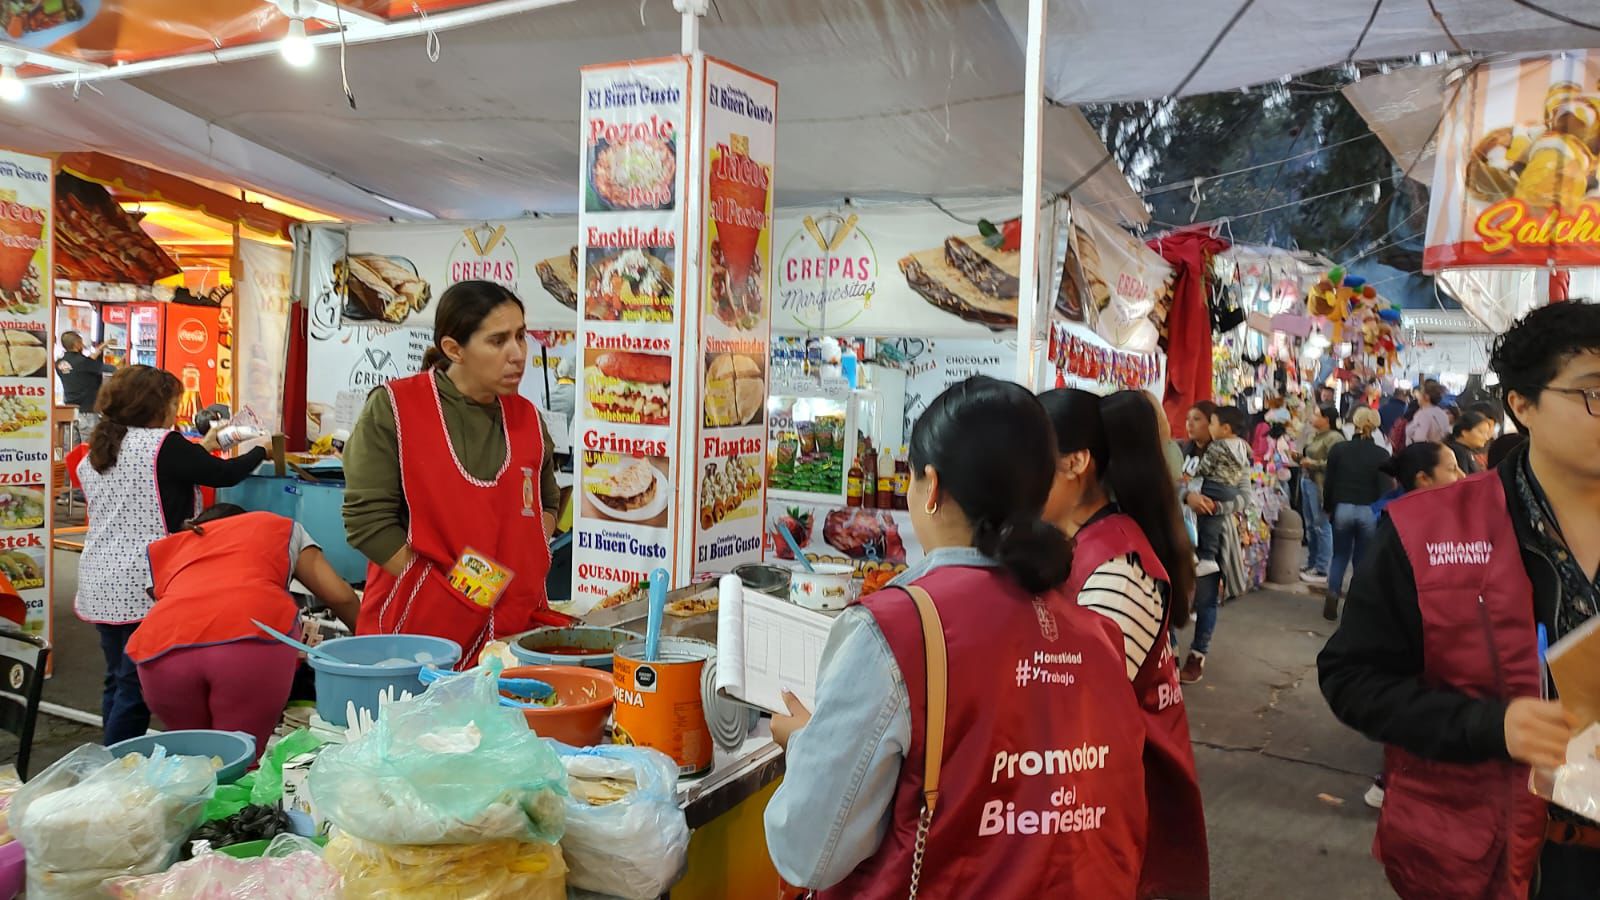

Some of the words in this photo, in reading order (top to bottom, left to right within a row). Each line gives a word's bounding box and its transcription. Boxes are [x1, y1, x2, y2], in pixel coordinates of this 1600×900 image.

[587, 89, 601, 109] El
[604, 87, 637, 108] Buen
[639, 86, 680, 105] Gusto
[709, 83, 719, 107] El
[720, 86, 745, 116] Buen
[746, 97, 773, 124] Gusto
[589, 114, 674, 146] Pozole
[717, 143, 769, 190] Tacos
[628, 181, 672, 209] Rojo
[587, 226, 675, 249] Enchiladas
[452, 261, 514, 283] CREPAS
[786, 256, 870, 283] CREPAS
[585, 332, 671, 350] Pambazos
[946, 355, 1000, 365] CHOCOLATE
[16, 450, 48, 462] Gusto
[584, 429, 667, 459] Gringas
[703, 436, 761, 459] Flautas
[578, 531, 592, 548] El
[595, 533, 626, 553] Buen
[629, 538, 667, 559] Gusto
[698, 544, 708, 563] El
[709, 543, 734, 560] Buen
[735, 536, 760, 553] Gusto
[577, 583, 589, 593] de
[1034, 651, 1082, 664] Honestidad
[991, 742, 1110, 783] Promotor
[1050, 785, 1076, 806] del
[978, 800, 1106, 837] Bienestar
